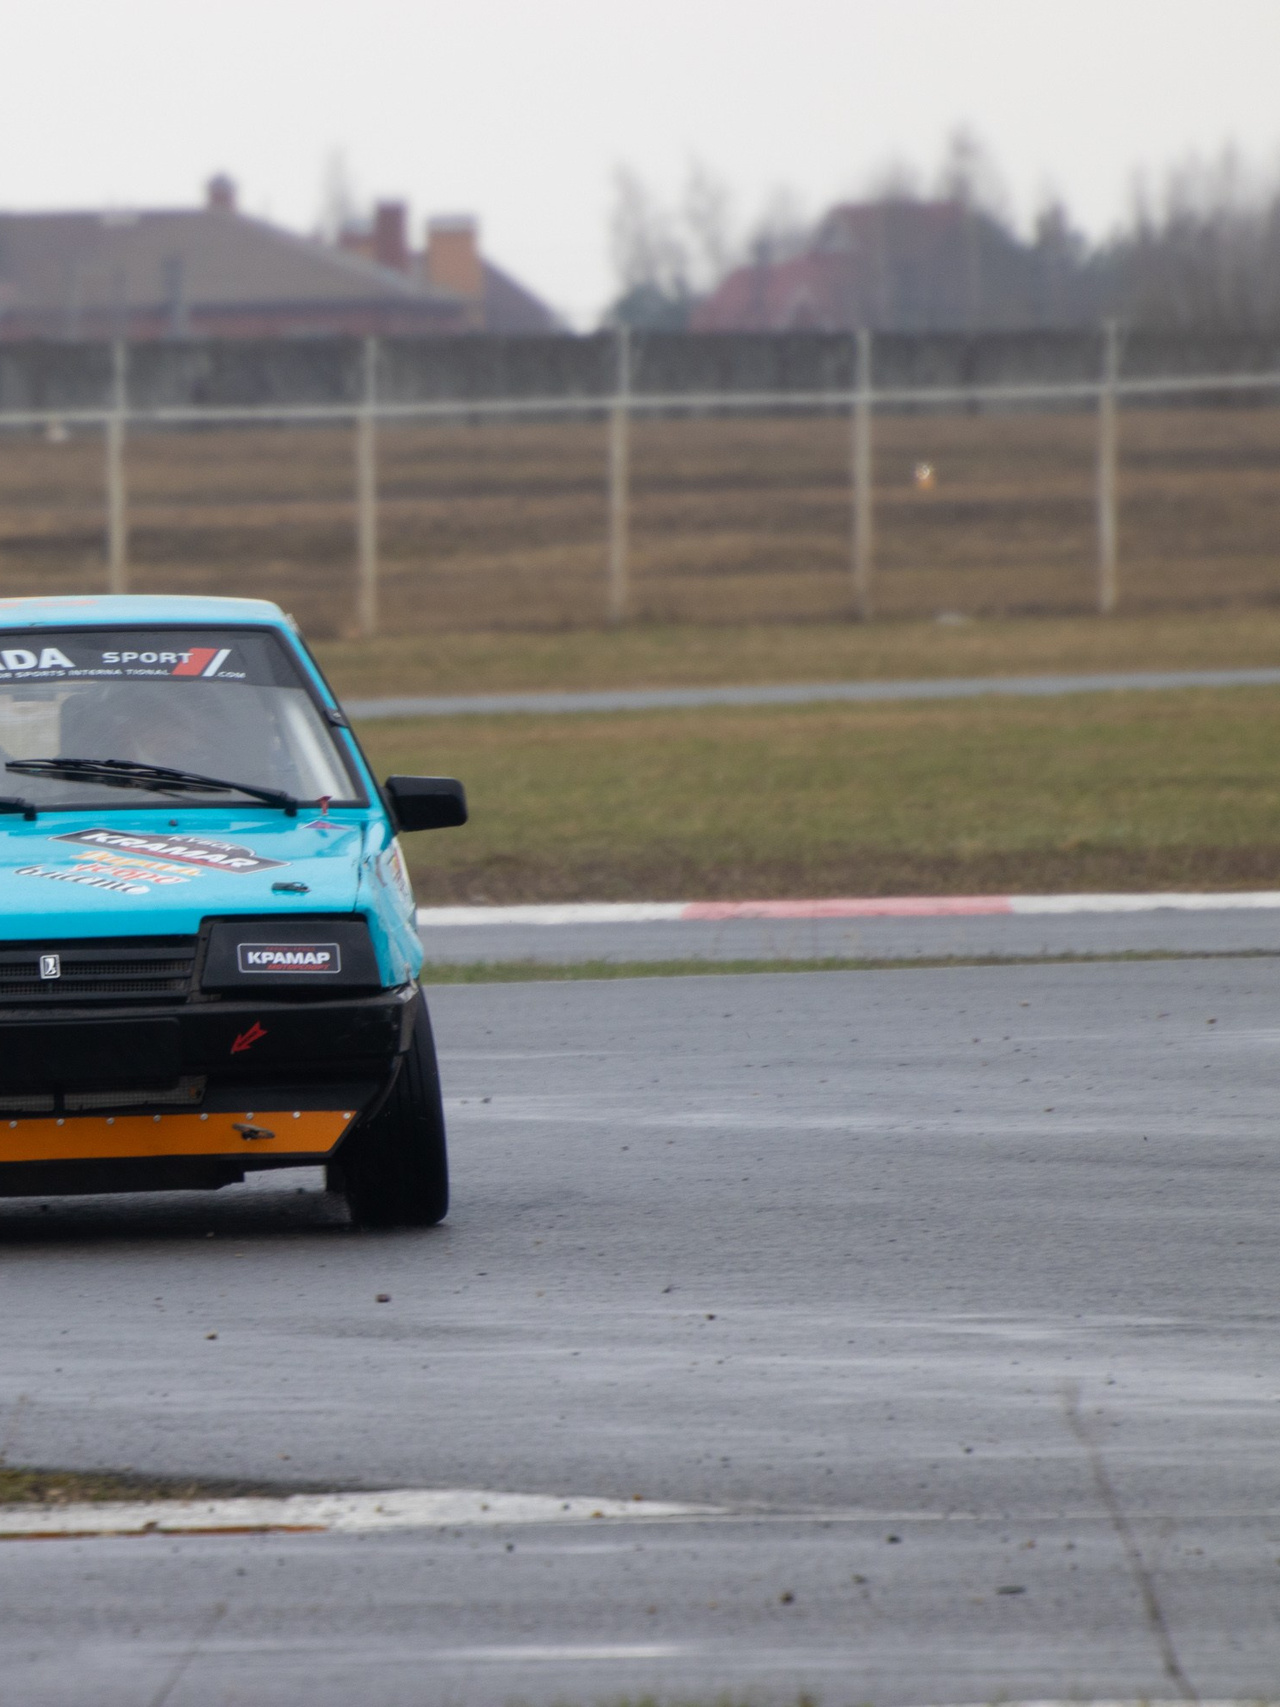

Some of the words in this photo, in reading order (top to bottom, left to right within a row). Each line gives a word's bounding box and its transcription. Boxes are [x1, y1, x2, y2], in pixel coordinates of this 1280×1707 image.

[101, 651, 194, 664] SPORT
[16, 669, 66, 679] SPORTS
[80, 832, 260, 868] KRAMAR
[247, 951, 330, 964] КРАМАР
